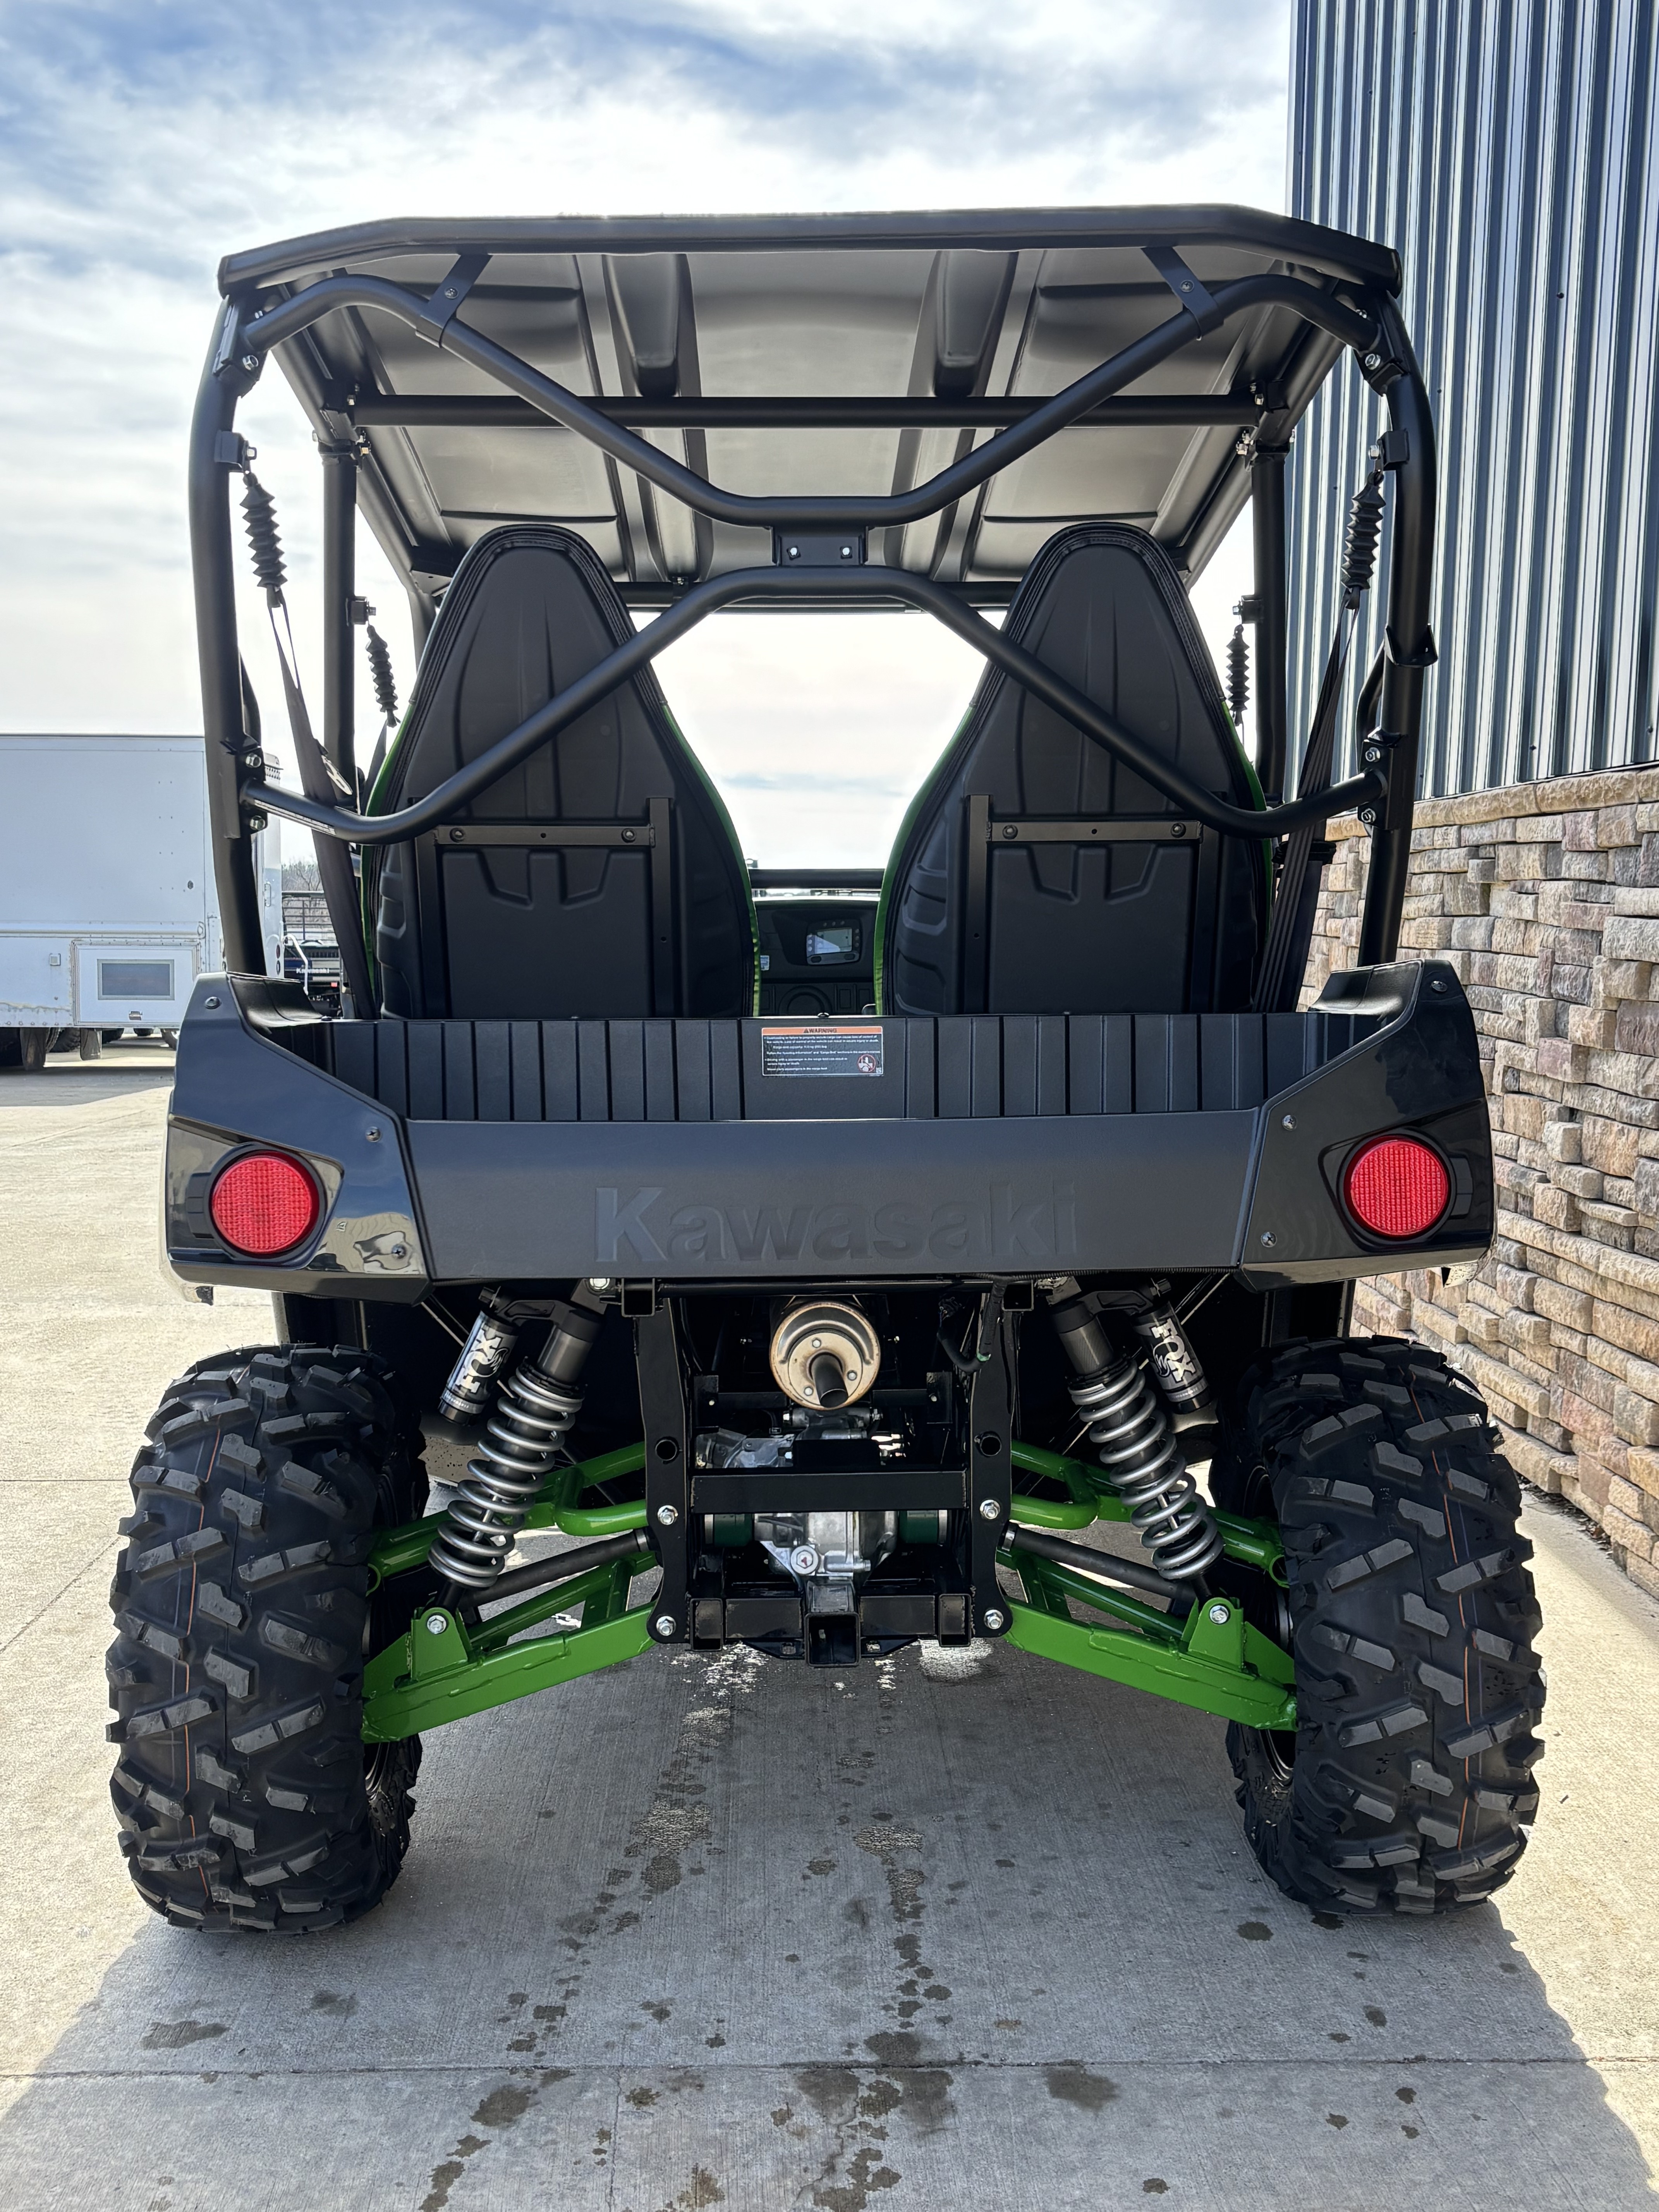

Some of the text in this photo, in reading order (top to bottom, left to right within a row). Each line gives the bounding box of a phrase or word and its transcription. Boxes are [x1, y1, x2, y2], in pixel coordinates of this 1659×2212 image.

[594, 1181, 1077, 1262] Kawasaki
[455, 1328, 508, 1393] FOX
[1151, 1318, 1196, 1382] FOX
